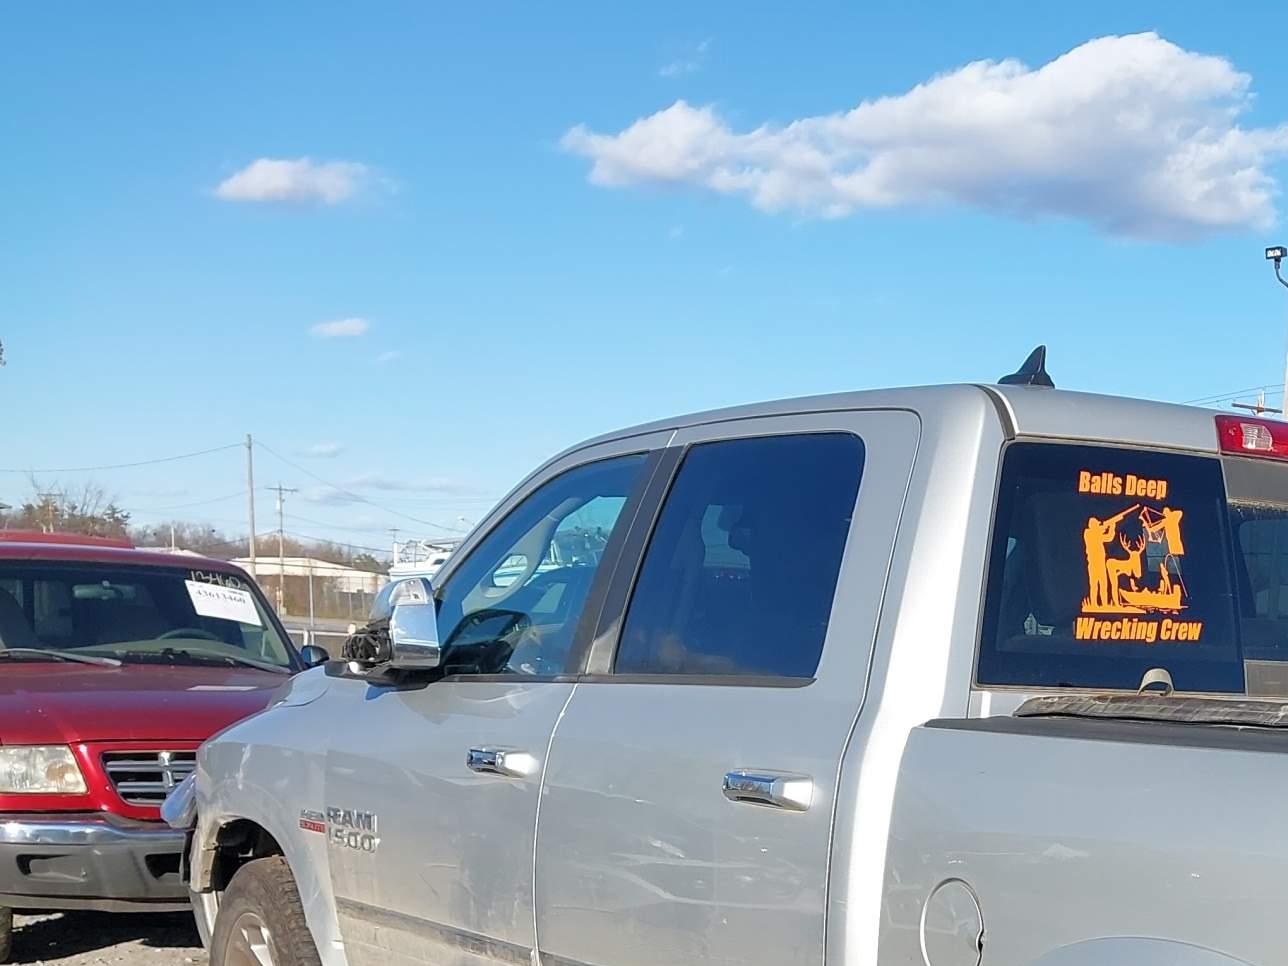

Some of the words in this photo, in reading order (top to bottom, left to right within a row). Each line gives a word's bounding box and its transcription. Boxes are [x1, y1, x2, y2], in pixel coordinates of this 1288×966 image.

[1078, 471, 1123, 495] Balls
[1124, 474, 1168, 500] Deep
[1075, 617, 1158, 643] Wrecking
[1159, 618, 1202, 641] Crew
[326, 805, 378, 832] RAM
[328, 827, 379, 853] 1500
